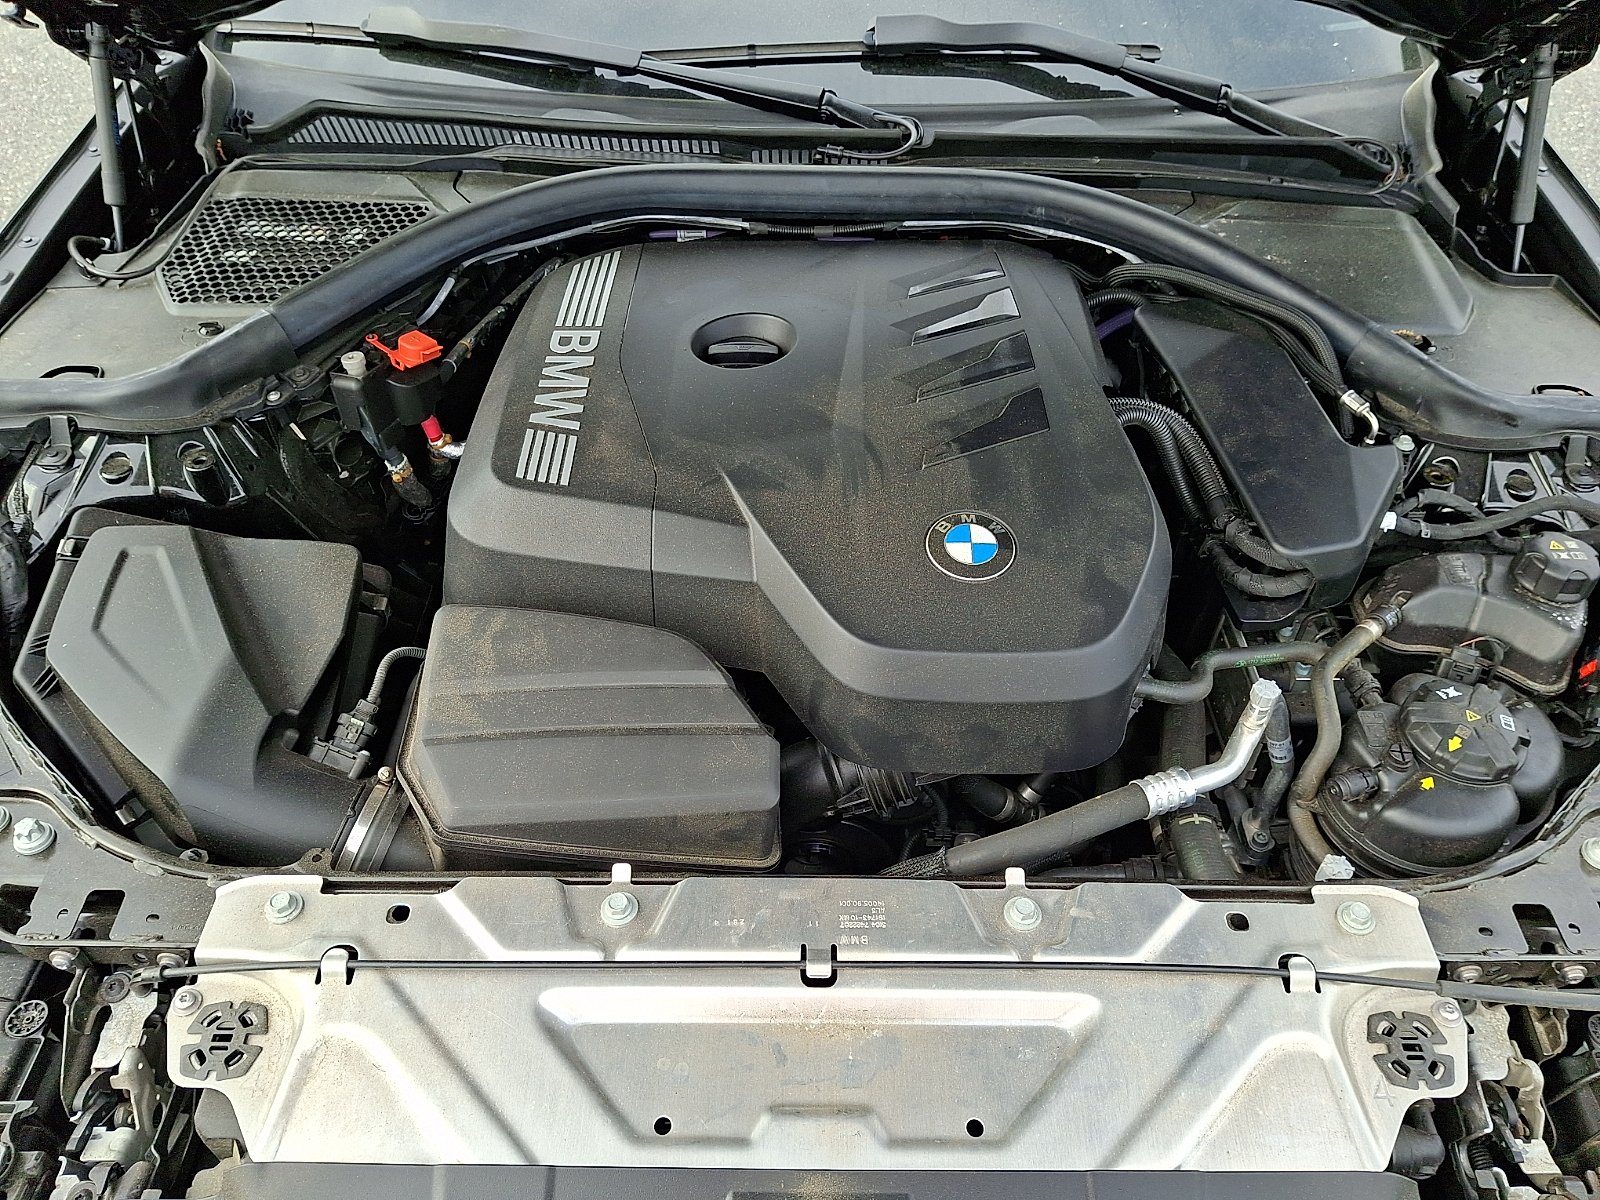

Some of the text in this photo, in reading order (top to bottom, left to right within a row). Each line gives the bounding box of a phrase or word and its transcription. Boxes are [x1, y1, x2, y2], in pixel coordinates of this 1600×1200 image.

[529, 330, 601, 431] BMW
[934, 514, 1006, 534] BMW
[839, 935, 869, 945] BMW
